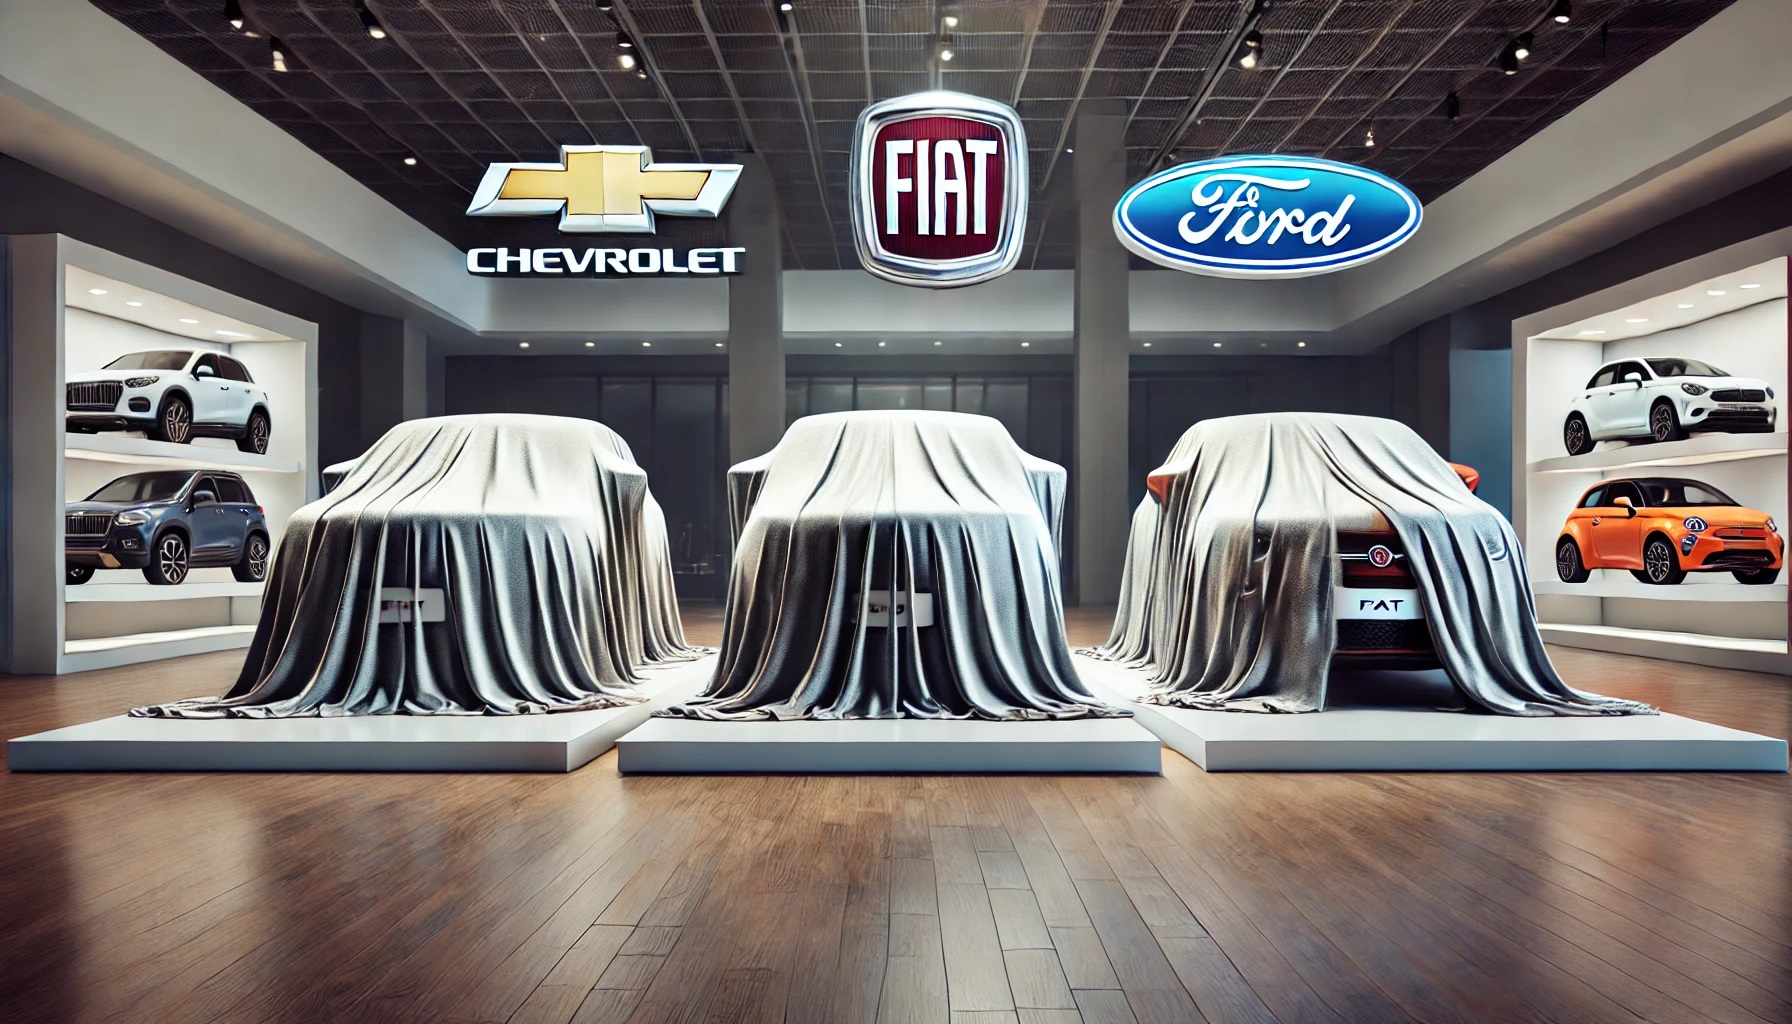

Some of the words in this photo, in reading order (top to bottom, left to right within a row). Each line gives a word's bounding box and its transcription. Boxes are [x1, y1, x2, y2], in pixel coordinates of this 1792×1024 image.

[885, 138, 998, 236] FIAT
[1178, 173, 1356, 247] Ford
[466, 247, 746, 273] CHEVROLET
